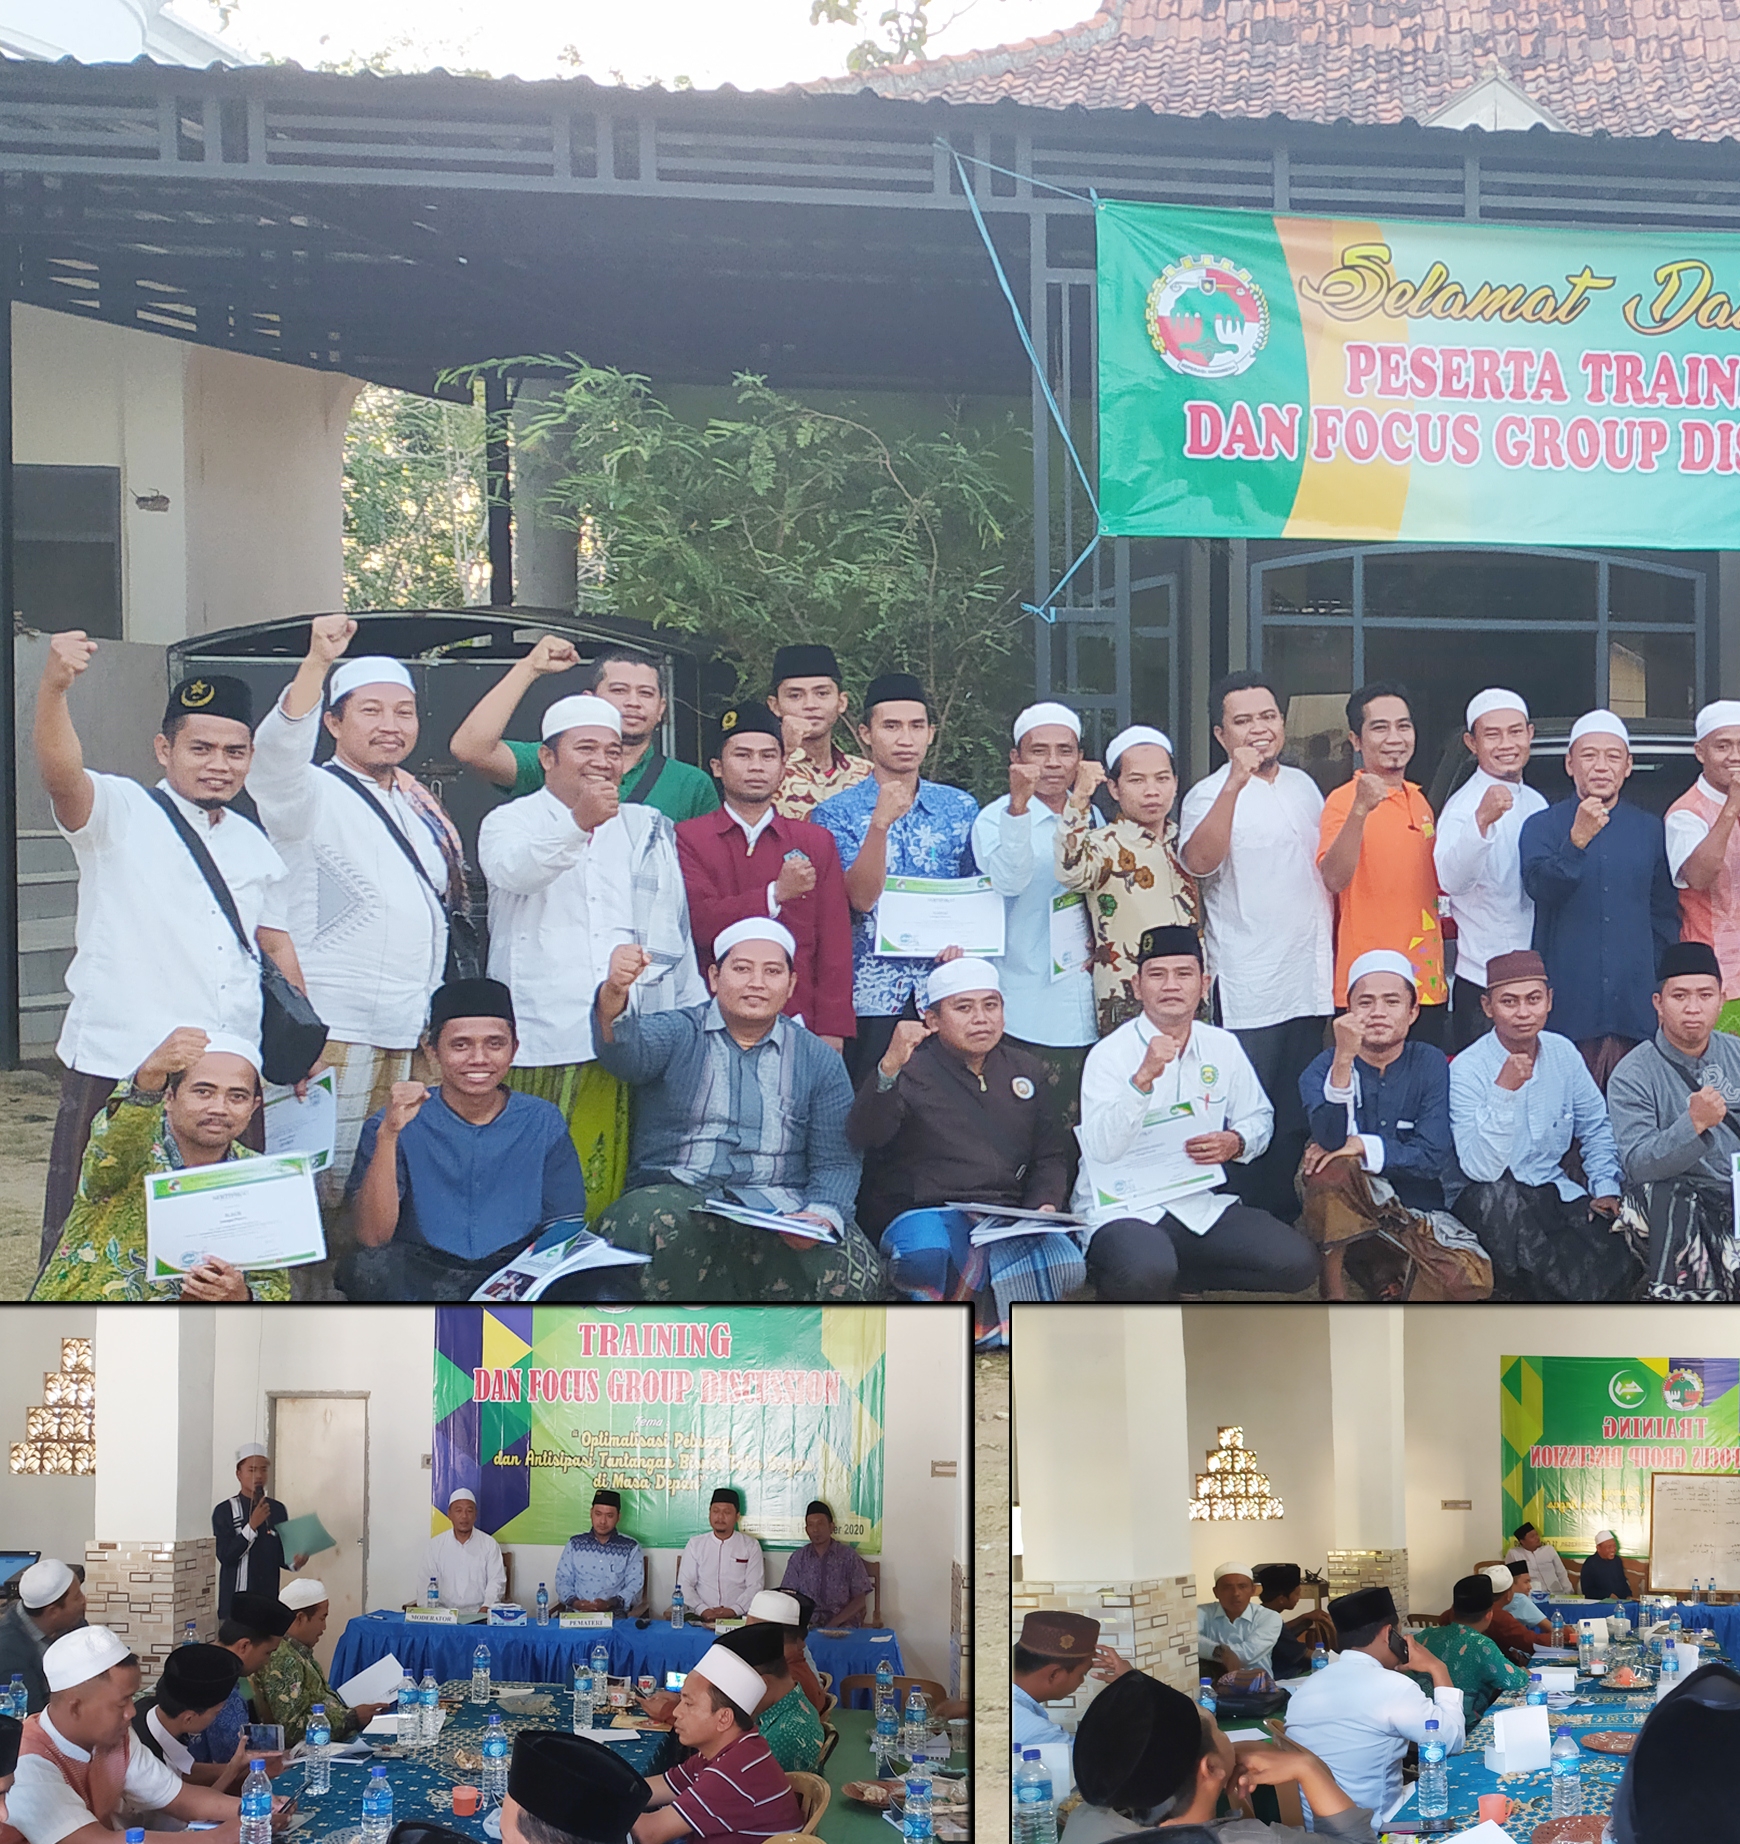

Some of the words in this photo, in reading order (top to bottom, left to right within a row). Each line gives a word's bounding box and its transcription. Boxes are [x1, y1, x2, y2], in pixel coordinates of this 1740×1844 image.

[1299, 244, 1614, 328] Selamat
[1345, 342, 1568, 403] PESERTA
[1185, 401, 1302, 460] DAN
[1311, 406, 1481, 468] FOCUS
[1494, 413, 1671, 475] GROUP
[578, 1322, 731, 1359] TRAINING
[473, 1368, 521, 1402] DAN
[528, 1369, 599, 1403] FOCUS
[606, 1369, 693, 1405] GROUP
[700, 1368, 842, 1406] DISCUSSION
[634, 1415, 663, 1427] Tema
[493, 1450, 522, 1467] dan
[525, 1449, 596, 1474] Antisipasi
[599, 1451, 675, 1475] Tantangan
[593, 1473, 609, 1488] di
[612, 1473, 651, 1489] Masa
[843, 1524, 864, 1535] 2020
[411, 1614, 452, 1622] MODERATOR
